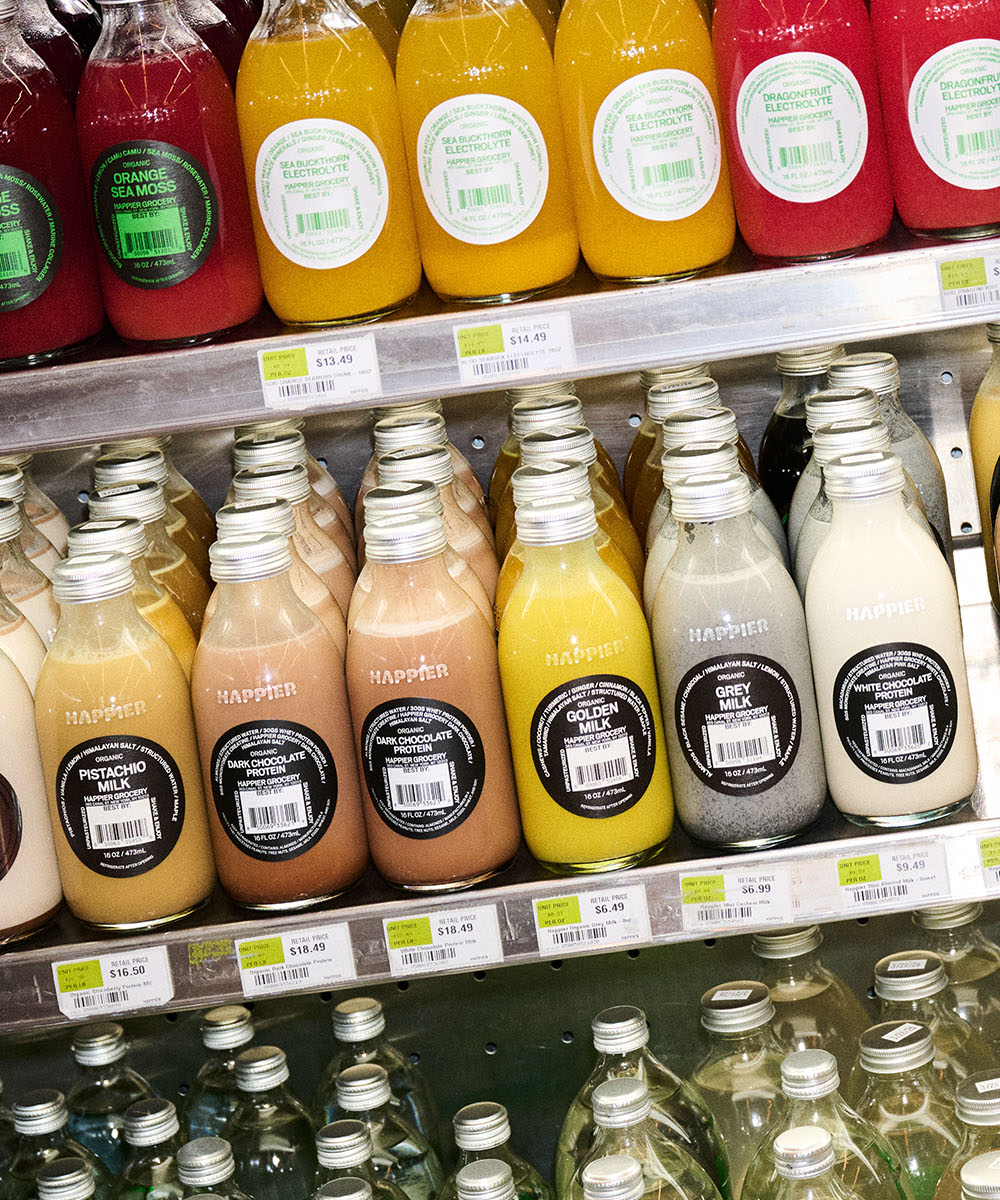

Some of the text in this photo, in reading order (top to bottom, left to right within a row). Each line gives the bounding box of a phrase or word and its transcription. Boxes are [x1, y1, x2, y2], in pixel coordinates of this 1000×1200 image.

[763, 85, 831, 103] DRAGONFRUIT
[765, 96, 833, 112] ELECTROLYTE
[442, 129, 511, 145] SEA BUCKTHORN
[445, 139, 511, 155] ELECTROLYTE
[280, 154, 350, 169] SEA BUCKTHORN
[113, 168, 168, 184] ORANGE
[283, 163, 349, 179] ELECTROLYTE
[111, 180, 176, 198] SEA MOSS
[510, 332, 547, 345] $14.49
[316, 355, 353, 367] $13.49
[370, 664, 448, 685] HAPPIER
[716, 683, 751, 698] GREY
[854, 673, 933, 693] WHITE CHOCOLATE
[875, 687, 912, 700] PROTEIN
[719, 695, 752, 711] MILK
[567, 703, 619, 722] GOLDEN
[579, 718, 611, 734] MILK
[228, 752, 306, 769] DARK CHOCOLATE
[79, 761, 146, 781] PISTACHIO
[246, 765, 286, 777] PROTEIN
[97, 778, 130, 792] MILK
[896, 860, 925, 872] $9.49
[742, 884, 771, 894] $6.99
[595, 902, 624, 914] $6.49
[438, 924, 473, 935] $18.49
[290, 942, 326, 956] $18.49
[110, 965, 145, 978] $16.50
